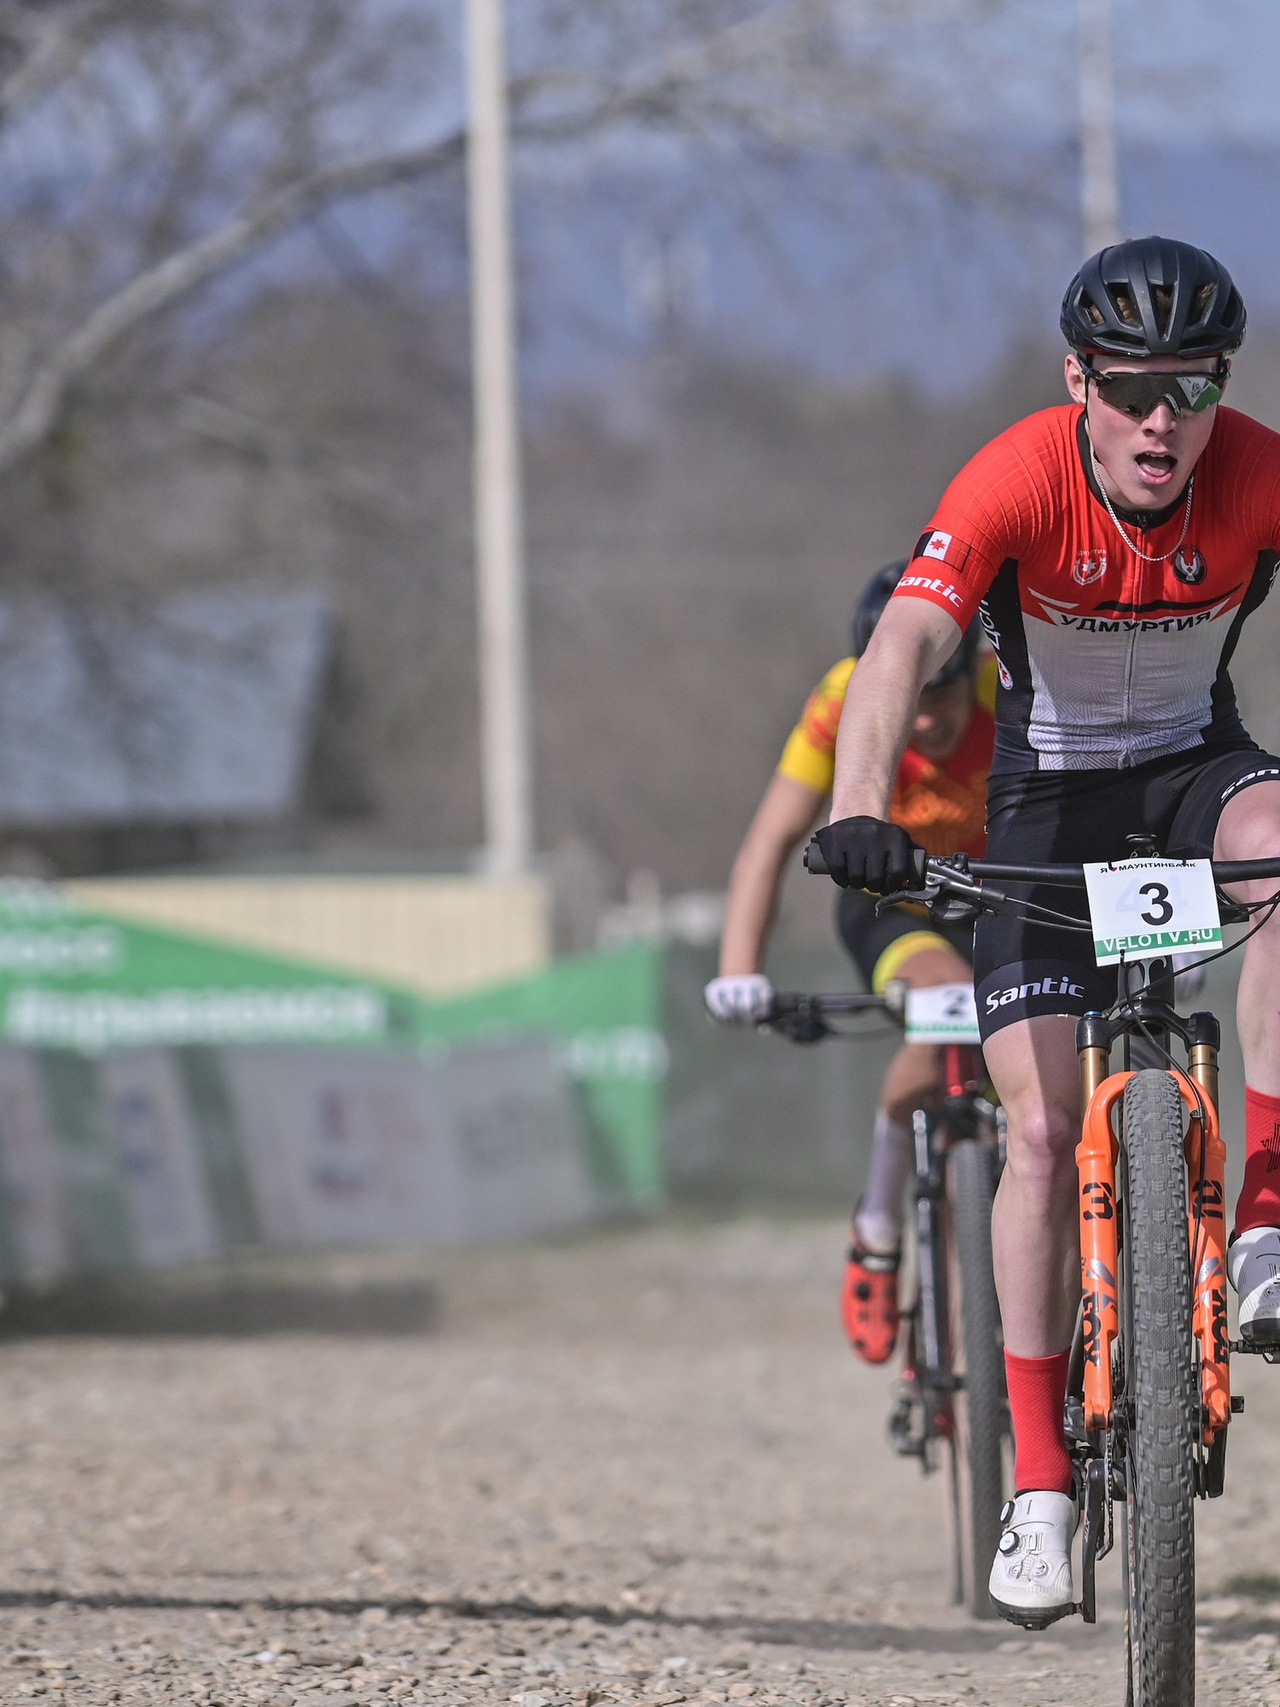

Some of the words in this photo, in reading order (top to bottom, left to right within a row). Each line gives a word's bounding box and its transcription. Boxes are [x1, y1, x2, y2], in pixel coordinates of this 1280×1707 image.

[1060, 611, 1211, 633] УДМУРТИЯ
[1138, 882, 1174, 926] 3
[986, 976, 1085, 1015] Santic
